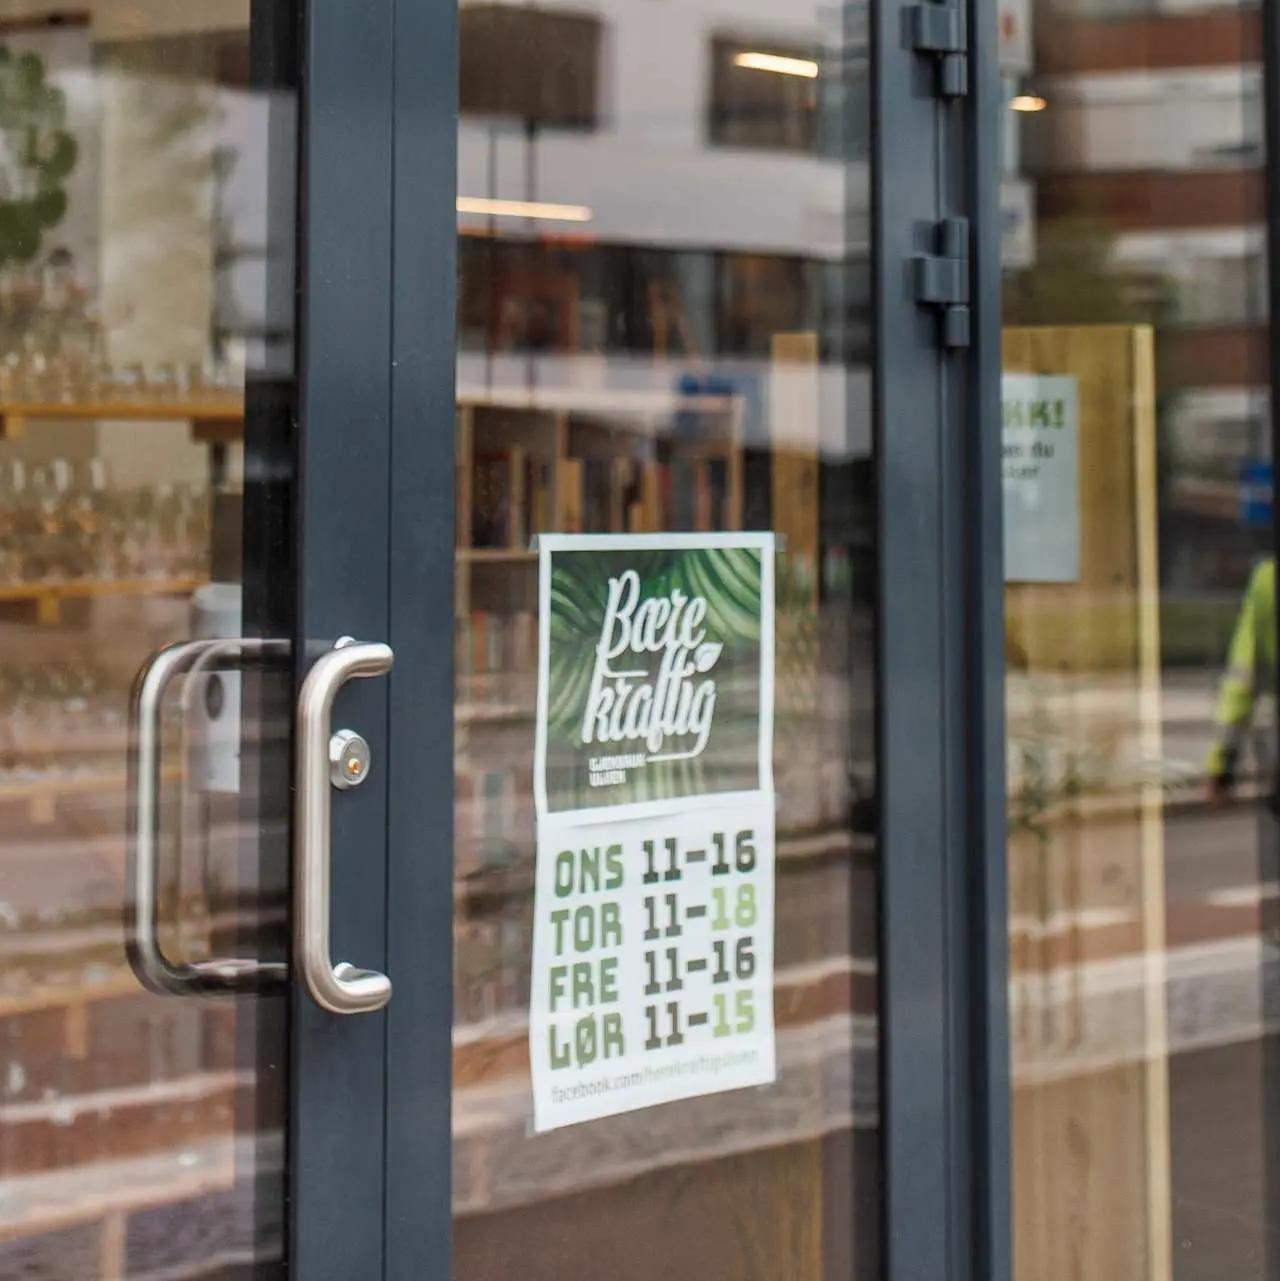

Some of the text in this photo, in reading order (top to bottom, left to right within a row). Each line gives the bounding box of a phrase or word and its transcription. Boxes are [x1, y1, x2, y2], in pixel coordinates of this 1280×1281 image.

[554, 829, 756, 898] ONS 11-16
[549, 882, 757, 957] TOR 11-18
[548, 936, 756, 1013] FRE 11-16
[547, 989, 756, 1070] LØR 11-15
